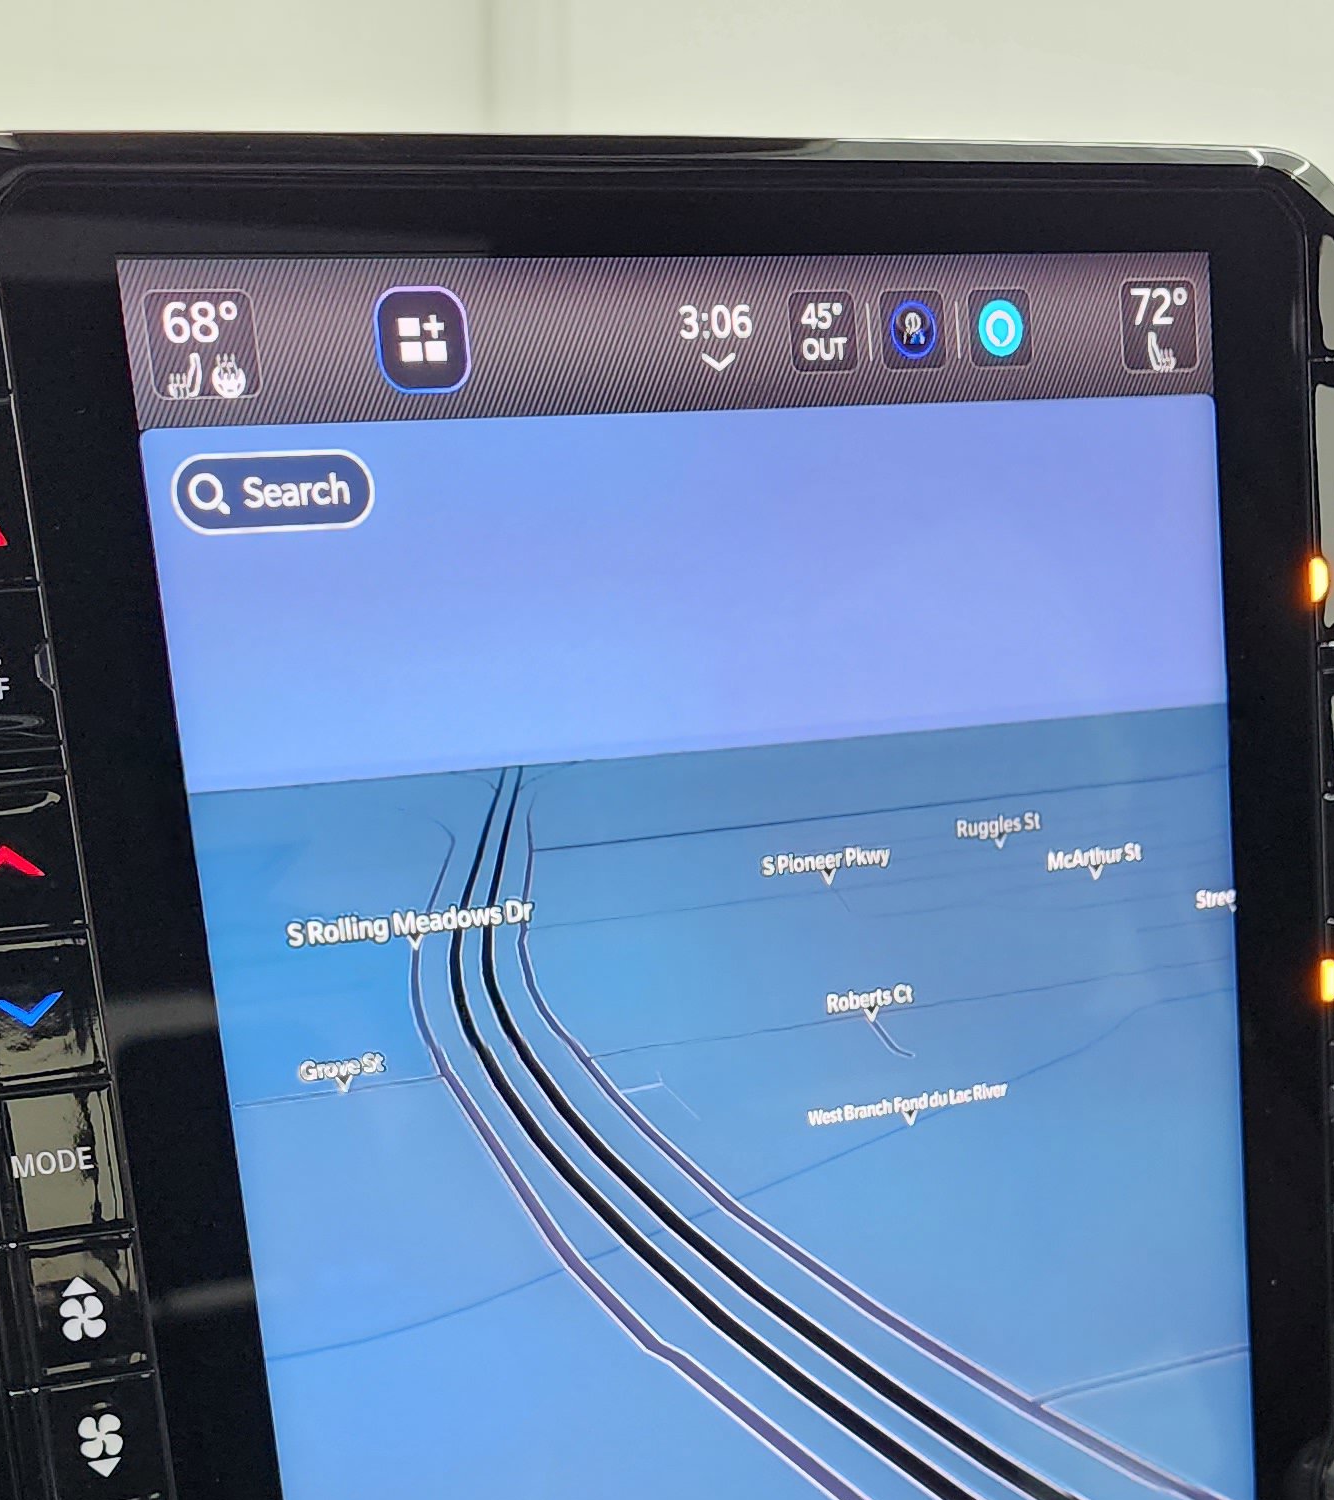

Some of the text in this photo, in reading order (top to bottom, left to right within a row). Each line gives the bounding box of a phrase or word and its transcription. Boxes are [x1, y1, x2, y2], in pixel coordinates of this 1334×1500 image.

[162, 299, 238, 344] 68°
[678, 303, 753, 341] 3:06
[800, 301, 843, 331] 45°
[1130, 286, 1188, 327] 72°
[801, 335, 847, 362] OUT
[242, 471, 351, 510] Search
[956, 812, 1041, 839] Ruggles St
[761, 846, 891, 877] S Pioneer Pkwy
[1047, 842, 1141, 871] McArthur St
[286, 899, 533, 946] S Rolling Meadows Dr
[826, 983, 914, 1014] Roberts Ct
[300, 1051, 385, 1081] Grove St
[808, 1109, 844, 1126] West
[843, 1100, 893, 1121] Branch
[894, 1093, 928, 1112] Fond
[973, 1082, 1008, 1100] River
[11, 1147, 95, 1178] MODE
